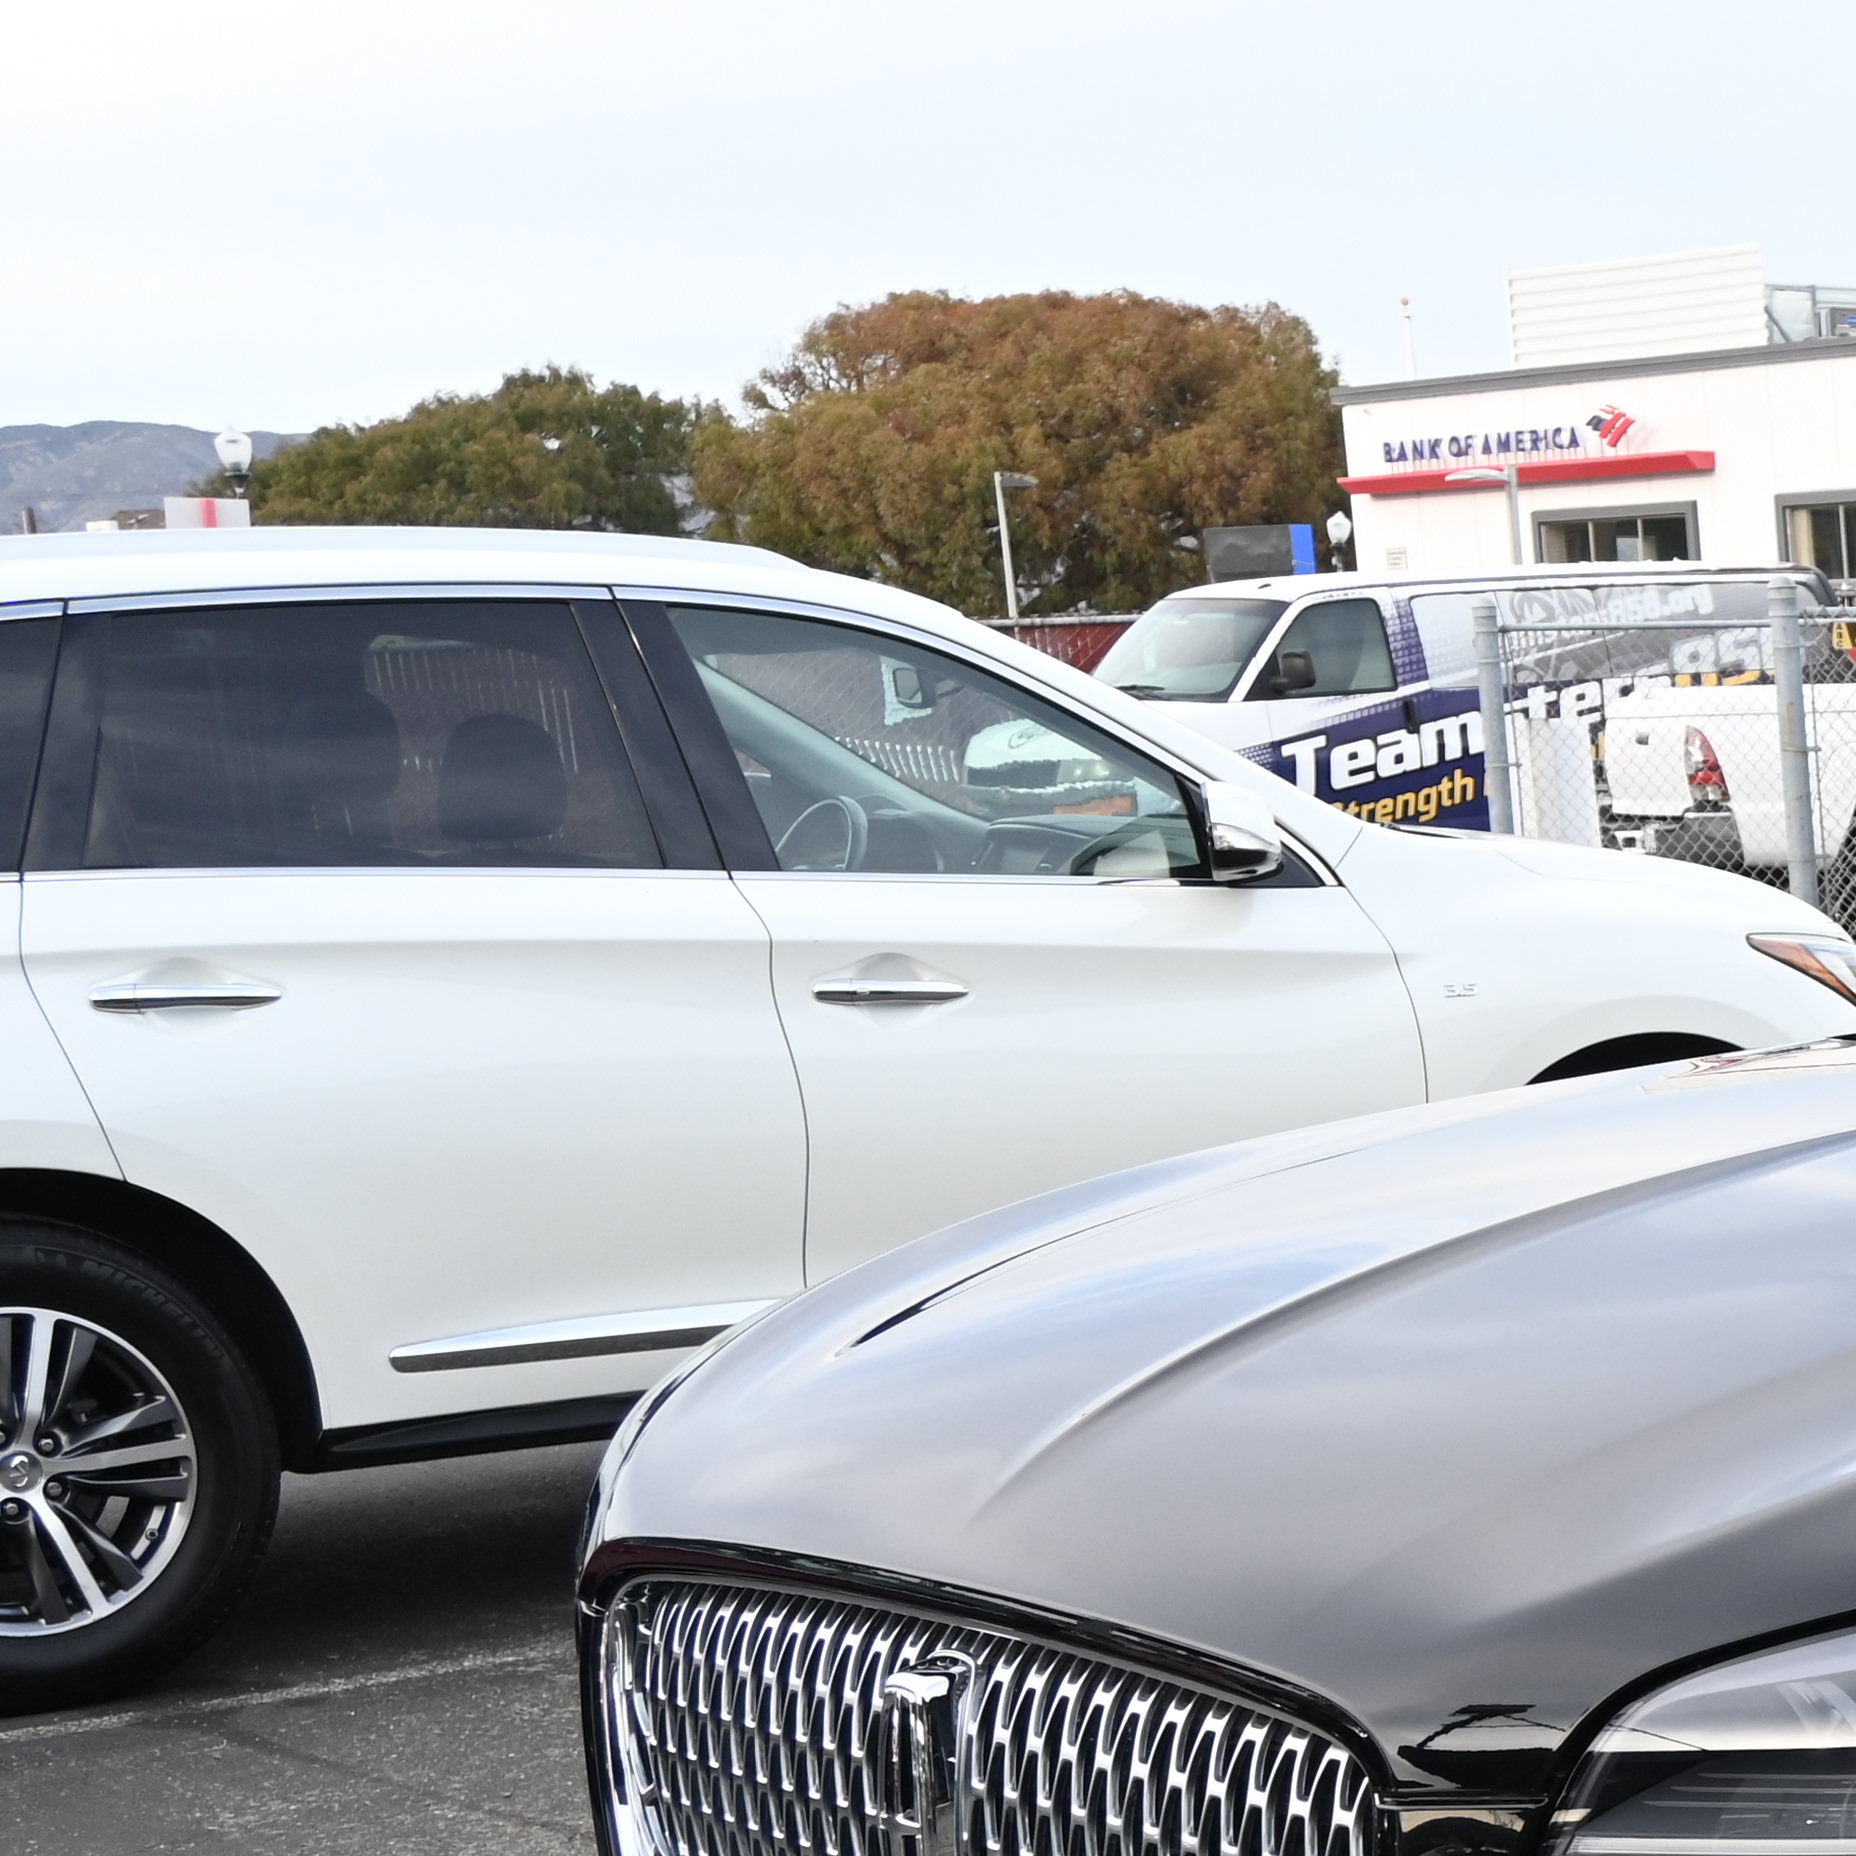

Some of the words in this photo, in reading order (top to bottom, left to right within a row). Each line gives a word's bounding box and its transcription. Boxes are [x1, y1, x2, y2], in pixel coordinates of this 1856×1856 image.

[1383, 438, 1442, 462] BANK
[1448, 434, 1476, 457] OF
[1481, 426, 1581, 455] AMERICA
[1444, 983, 1478, 998] 3.5
